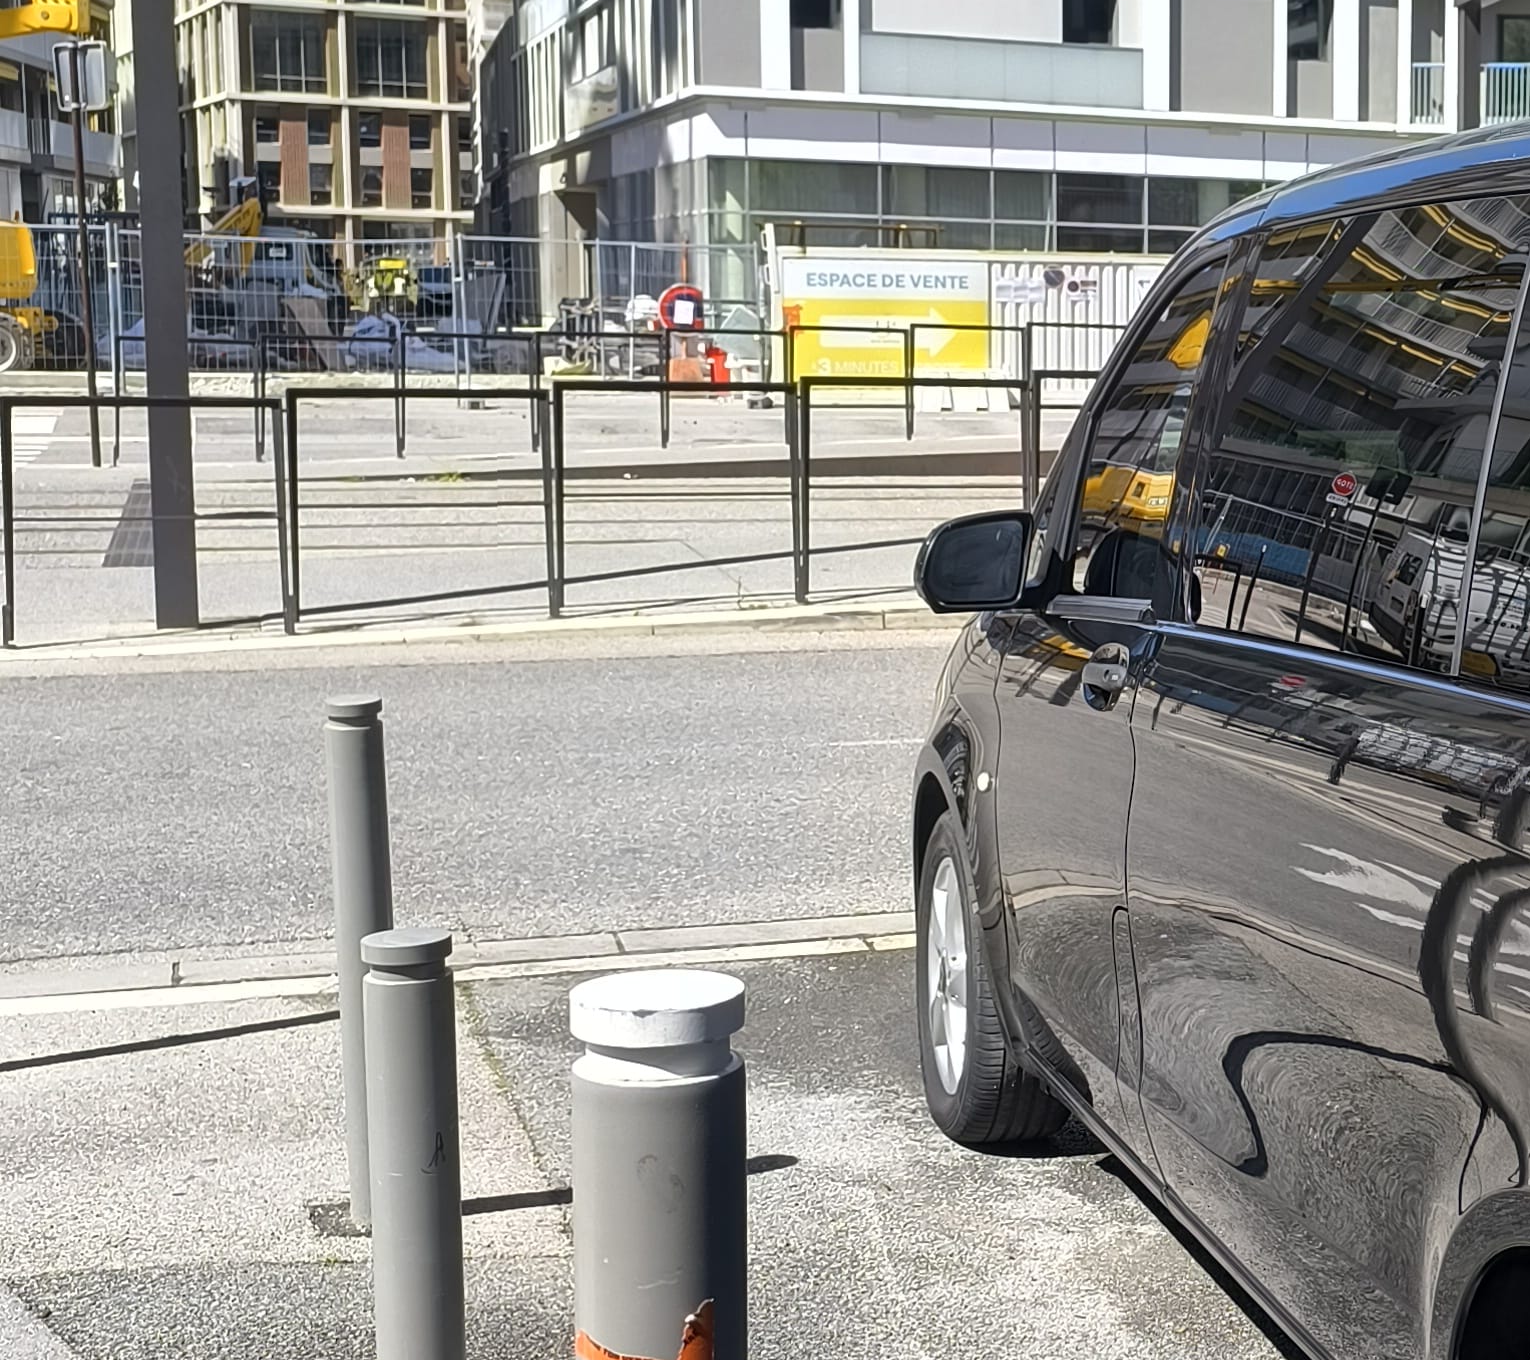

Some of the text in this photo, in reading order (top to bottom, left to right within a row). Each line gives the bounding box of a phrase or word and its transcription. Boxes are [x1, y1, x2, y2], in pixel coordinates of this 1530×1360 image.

[806, 272, 969, 290] ESPACE DE VENTE
[834, 359, 899, 374] MINUTES
